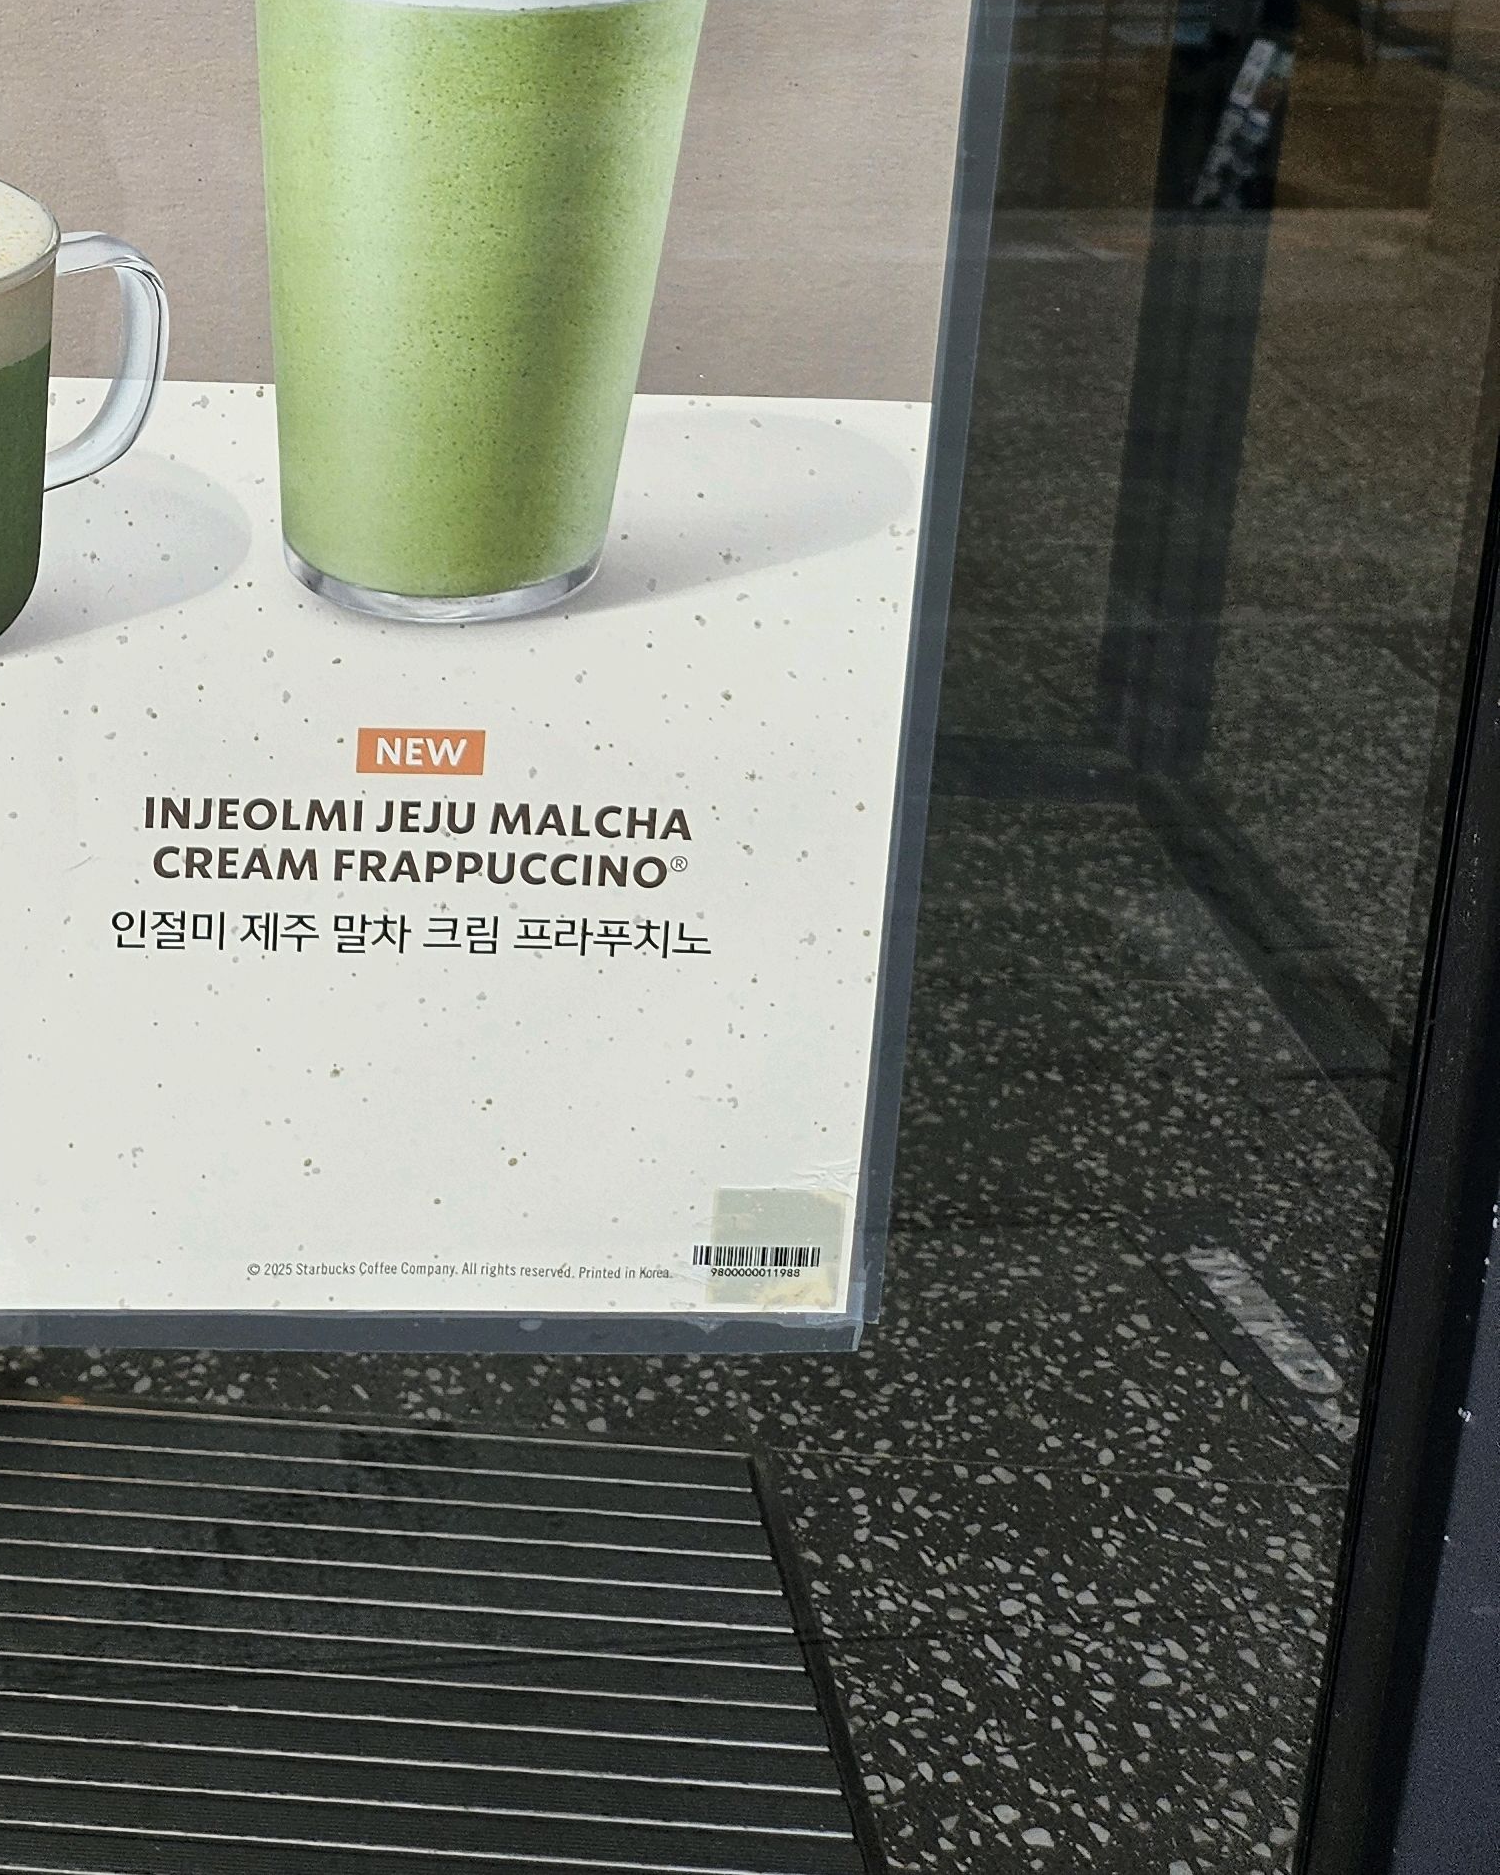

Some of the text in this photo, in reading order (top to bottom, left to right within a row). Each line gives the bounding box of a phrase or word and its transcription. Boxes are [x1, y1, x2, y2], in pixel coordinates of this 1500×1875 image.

[376, 737, 467, 767] NEW
[144, 796, 692, 841] INJEOLMI JEJU MALCHA
[153, 845, 318, 881] CREAM
[111, 910, 712, 959] 인절미 제주 말차 크림 프라푸치노
[264, 1262, 293, 1276] 2025
[295, 1262, 356, 1276] Starbucks
[358, 1261, 398, 1276] Coffee
[400, 1261, 459, 1278] Company.
[461, 1261, 477, 1276] All
[480, 1262, 517, 1278] rights
[519, 1264, 575, 1279] reserved.
[578, 1266, 621, 1279] Printed
[625, 1266, 636, 1279] in
[639, 1267, 673, 1280] Korea.
[710, 1267, 801, 1278] 9800000011988
